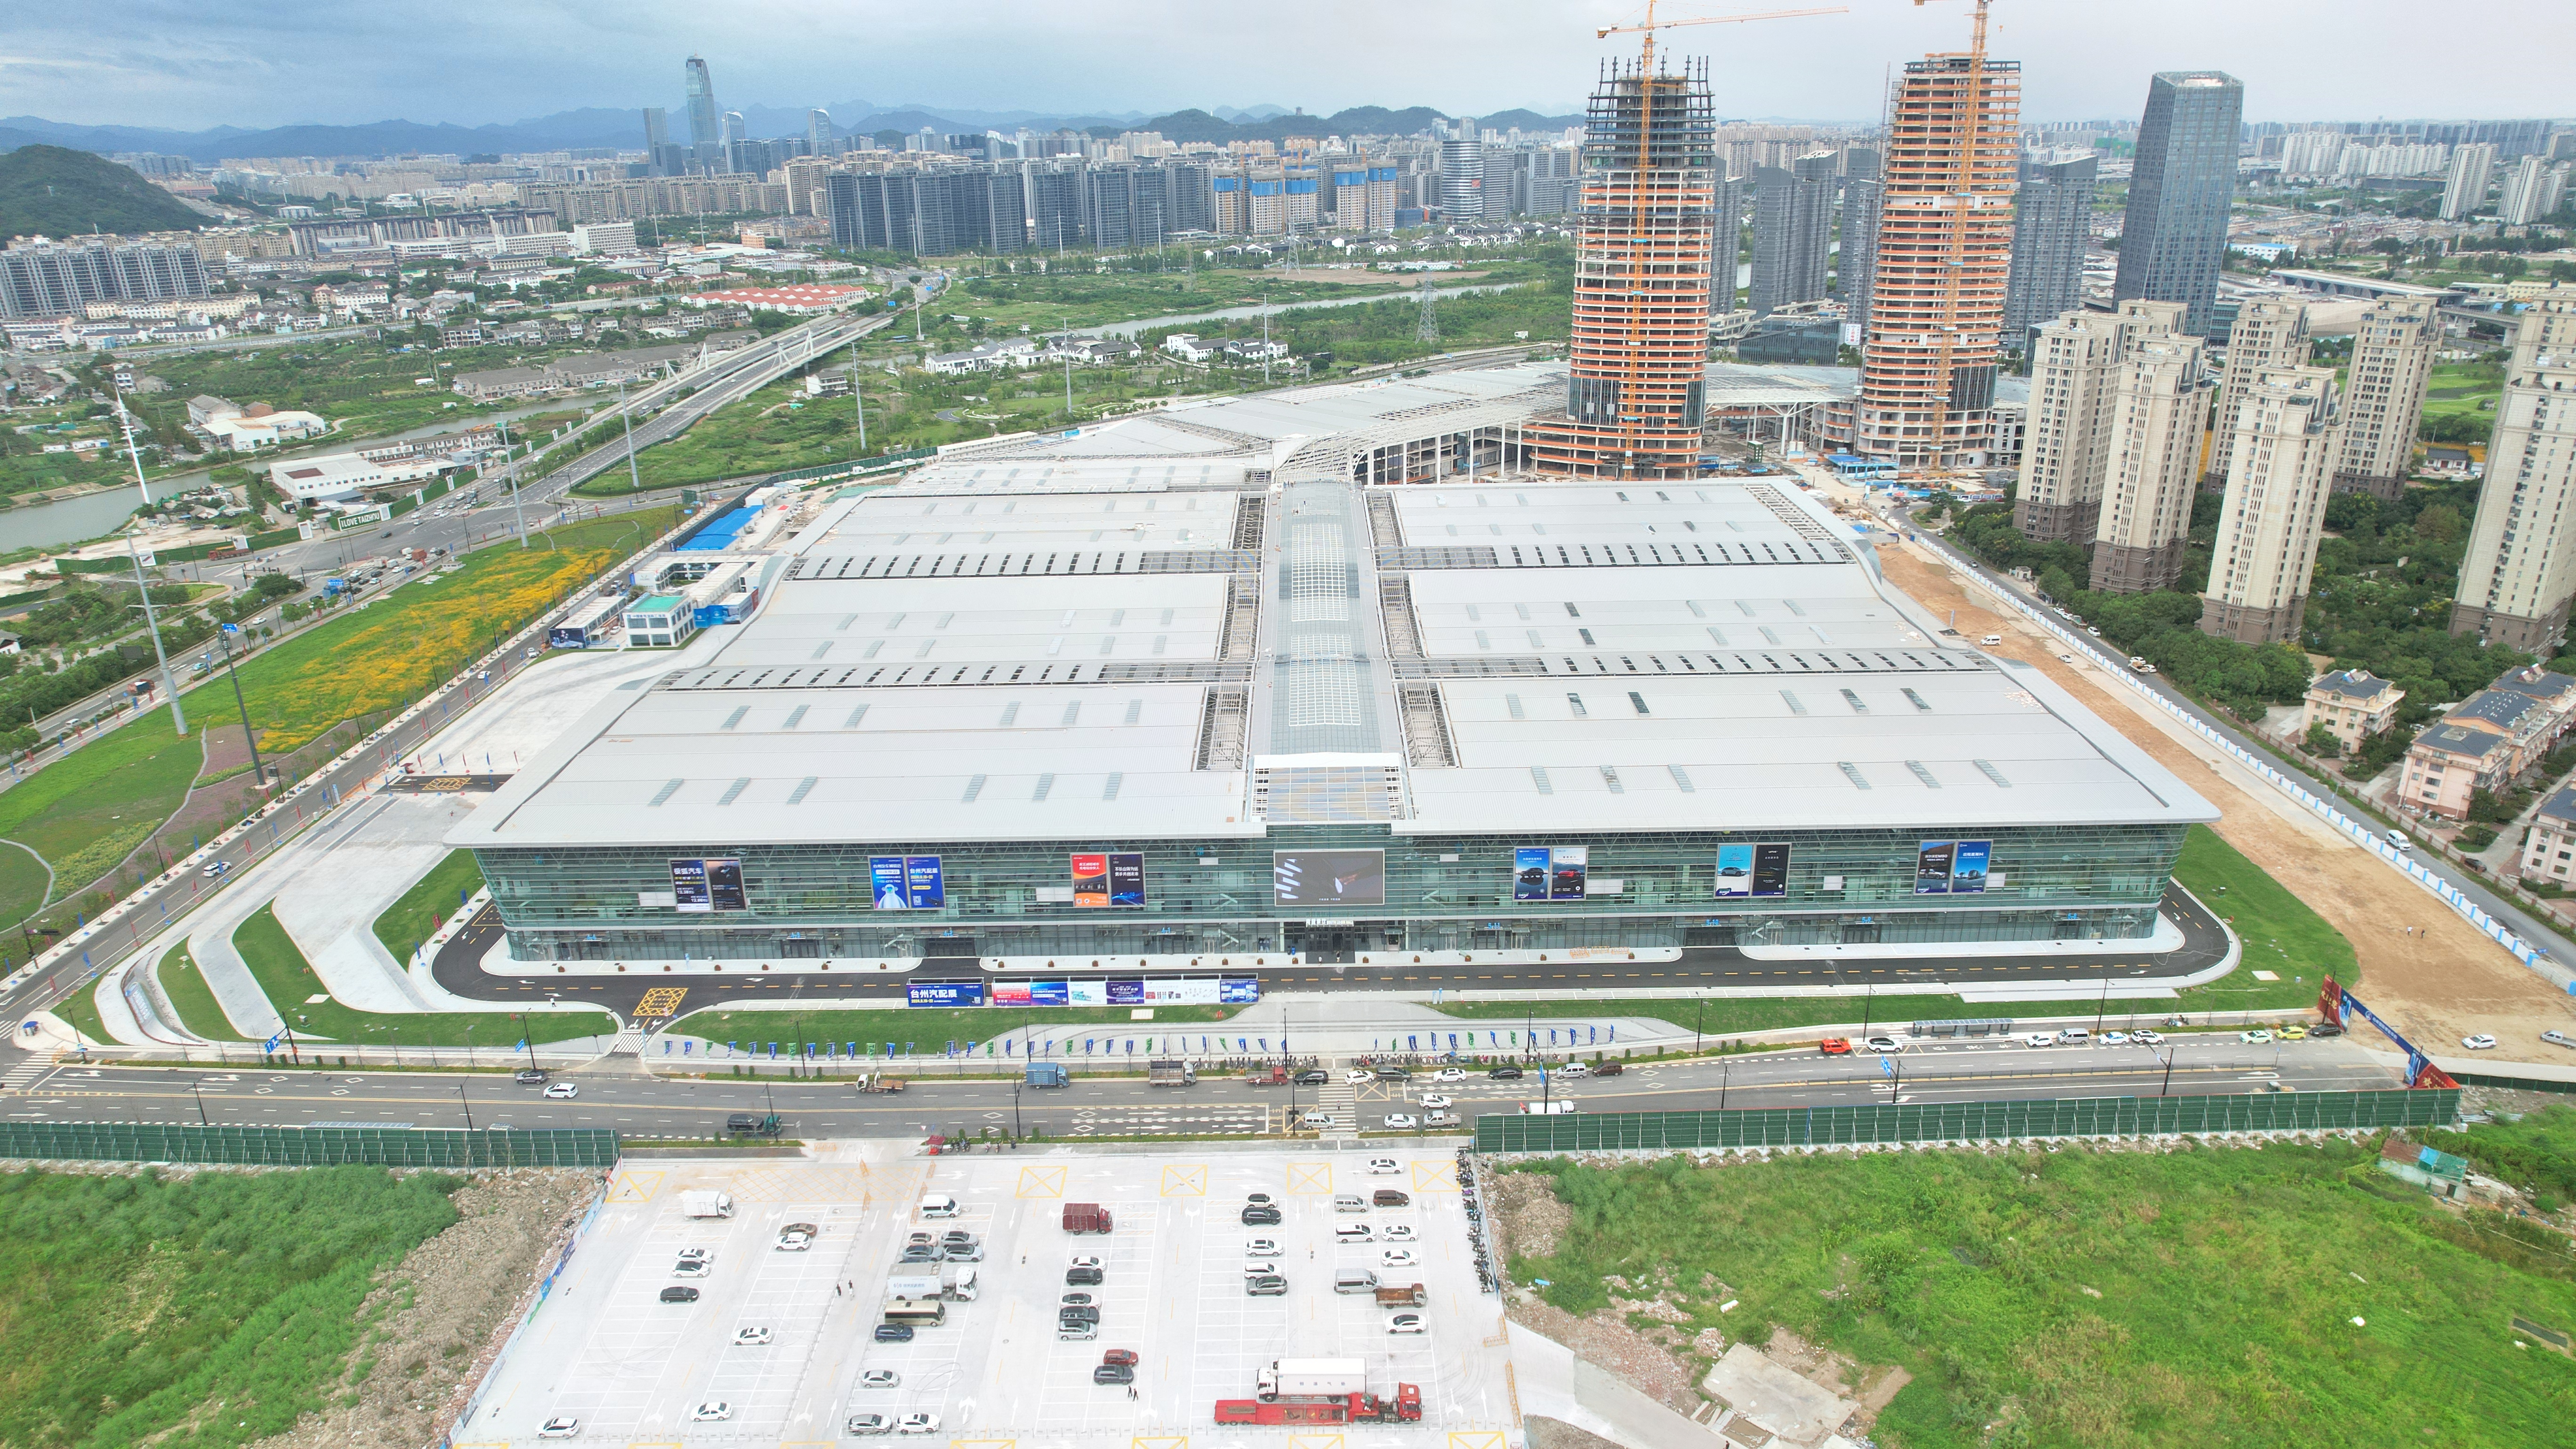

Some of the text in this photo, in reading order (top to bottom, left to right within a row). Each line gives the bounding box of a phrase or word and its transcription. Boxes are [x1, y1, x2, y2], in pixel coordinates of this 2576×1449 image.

[344, 518, 358, 527] LOVE
[358, 512, 380, 523] TAIZHOU
[910, 990, 957, 998] 台州汽配展
